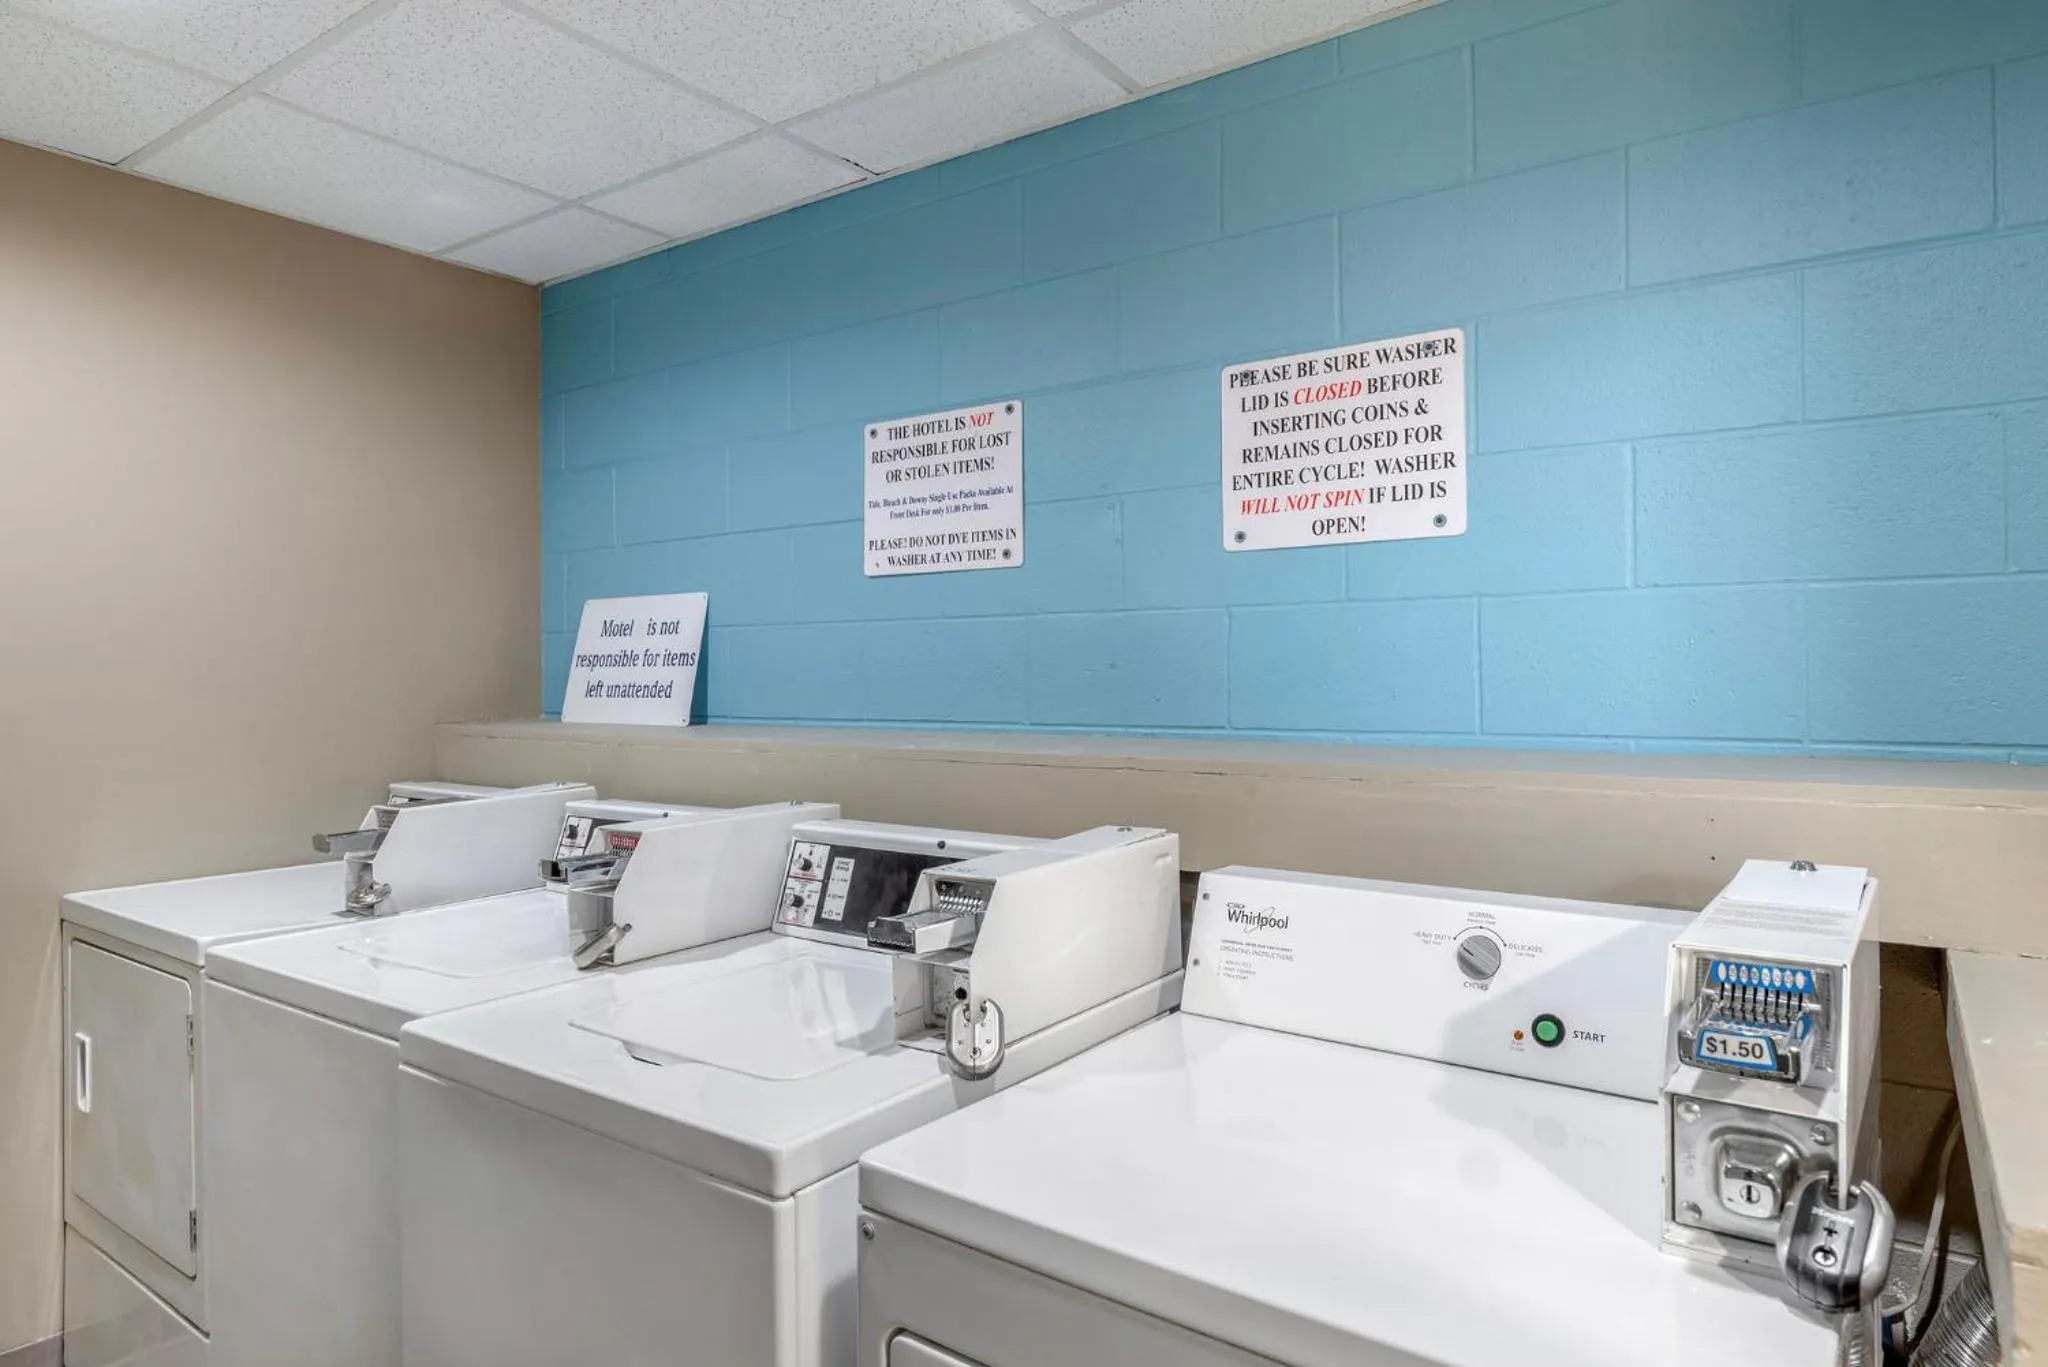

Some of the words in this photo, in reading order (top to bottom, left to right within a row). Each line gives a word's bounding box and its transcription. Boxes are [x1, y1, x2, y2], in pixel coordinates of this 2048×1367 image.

[1297, 360, 1319, 377] BE
[1323, 351, 1370, 373] SURE
[1241, 394, 1269, 412] LID
[1274, 391, 1289, 407] IS
[1294, 380, 1362, 405] CLOSED
[1367, 368, 1443, 394] BEFORE
[888, 426, 910, 441] THE
[913, 418, 952, 436] HOTEL
[955, 417, 966, 431] IS
[969, 412, 994, 429] NOT
[1252, 409, 1346, 436] INSERTING
[1351, 403, 1408, 424] COINS
[1414, 398, 1429, 415] &
[871, 441, 948, 464] RESPONSIBLE
[952, 438, 976, 453] FOR
[979, 431, 1012, 448] LOST
[1242, 440, 1320, 463] REMAINS
[1325, 431, 1398, 454] CLOSED
[1404, 424, 1443, 444] FOR
[886, 468, 902, 483] OR
[905, 462, 950, 481] STOLEN
[953, 456, 995, 474] ITEMS!
[1232, 470, 1294, 491] ENTIRE
[1299, 461, 1365, 484] CYCLE!
[1375, 451, 1456, 474] WASHER
[1240, 496, 1280, 516] WILL
[1284, 493, 1320, 512] NOT
[1323, 489, 1365, 509] SPIN
[1369, 486, 1386, 504] IF
[1391, 483, 1423, 502] LID
[1430, 481, 1447, 498] IS
[1312, 516, 1365, 536] OPEN!
[869, 537, 907, 551] PLEASE!
[910, 536, 923, 548] DO
[925, 534, 947, 546] NOT
[949, 531, 968, 545] DYE
[971, 528, 1003, 542] ITEMS
[1006, 528, 1016, 540] IN
[888, 552, 929, 567] WASHER
[929, 552, 942, 564] AT
[942, 550, 964, 563] ANY
[967, 548, 996, 561] TIME!
[600, 619, 634, 637] Motel
[647, 618, 657, 636] is
[660, 618, 680, 635] not
[576, 650, 639, 672] responsible
[642, 649, 660, 667] for
[662, 649, 696, 666] items
[585, 680, 604, 698] left
[606, 680, 674, 698] unattended
[1227, 909, 1289, 931] Whirlpool
[1573, 1030, 1605, 1043] START
[1705, 1037, 1764, 1059] $1.50
